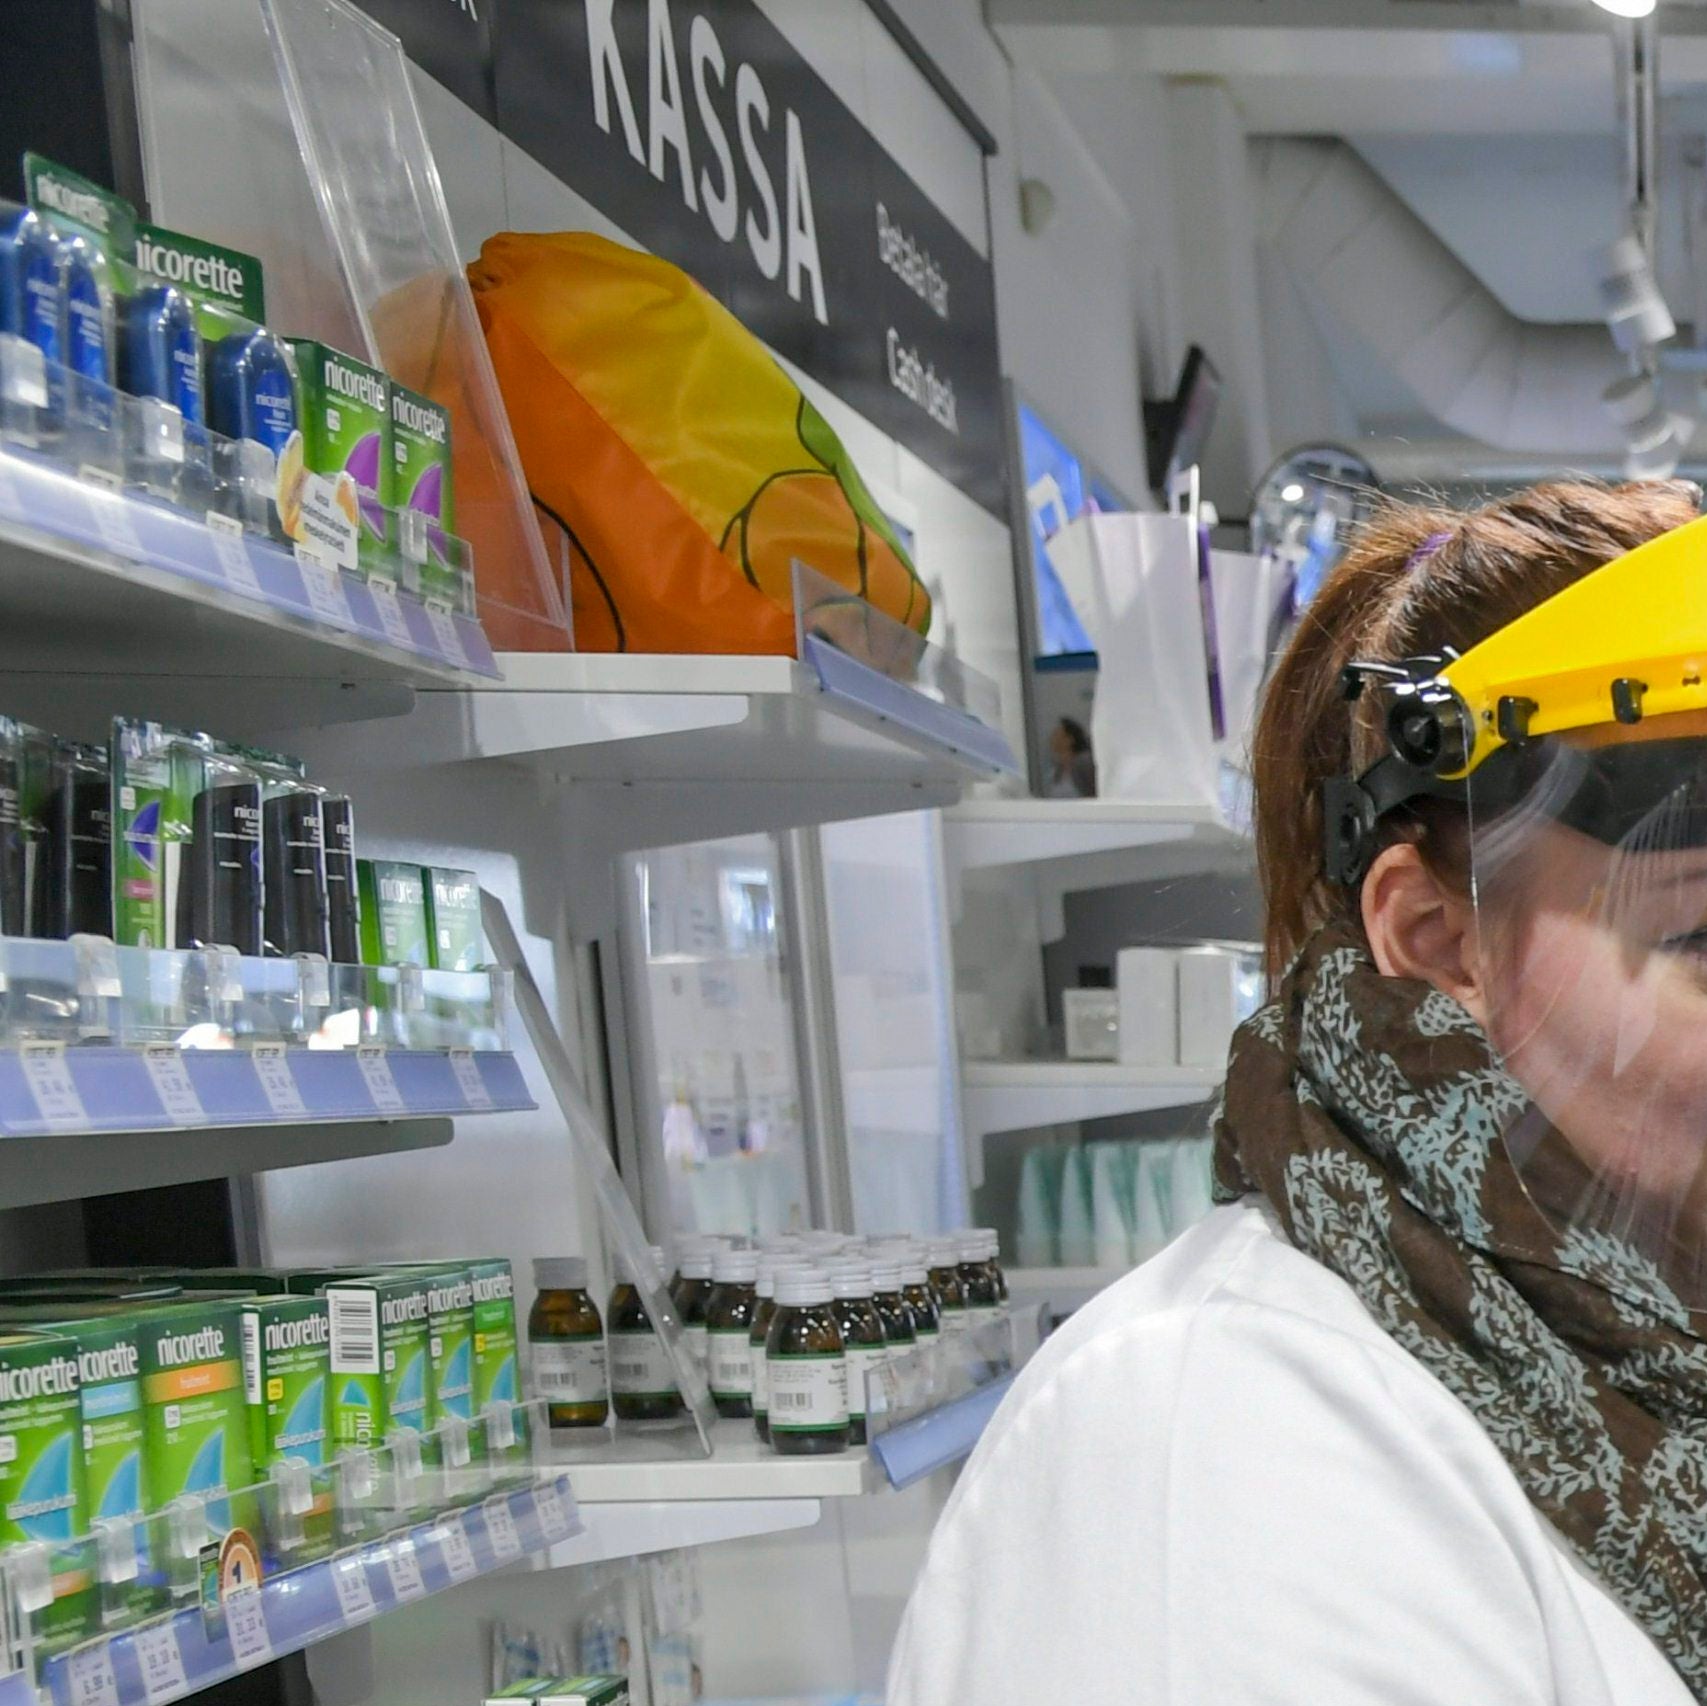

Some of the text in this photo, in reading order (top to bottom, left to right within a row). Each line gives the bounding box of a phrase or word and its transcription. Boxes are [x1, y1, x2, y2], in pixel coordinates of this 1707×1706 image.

[586, 0, 829, 325] KASSA
[325, 356, 386, 412] nicorette
[393, 391, 446, 443] nicorette
[382, 1293, 427, 1324] nicorette
[428, 1283, 472, 1315] nicorette
[158, 1325, 225, 1366] nicorette
[266, 1317, 329, 1352] nicorette
[78, 1343, 139, 1383] icorette
